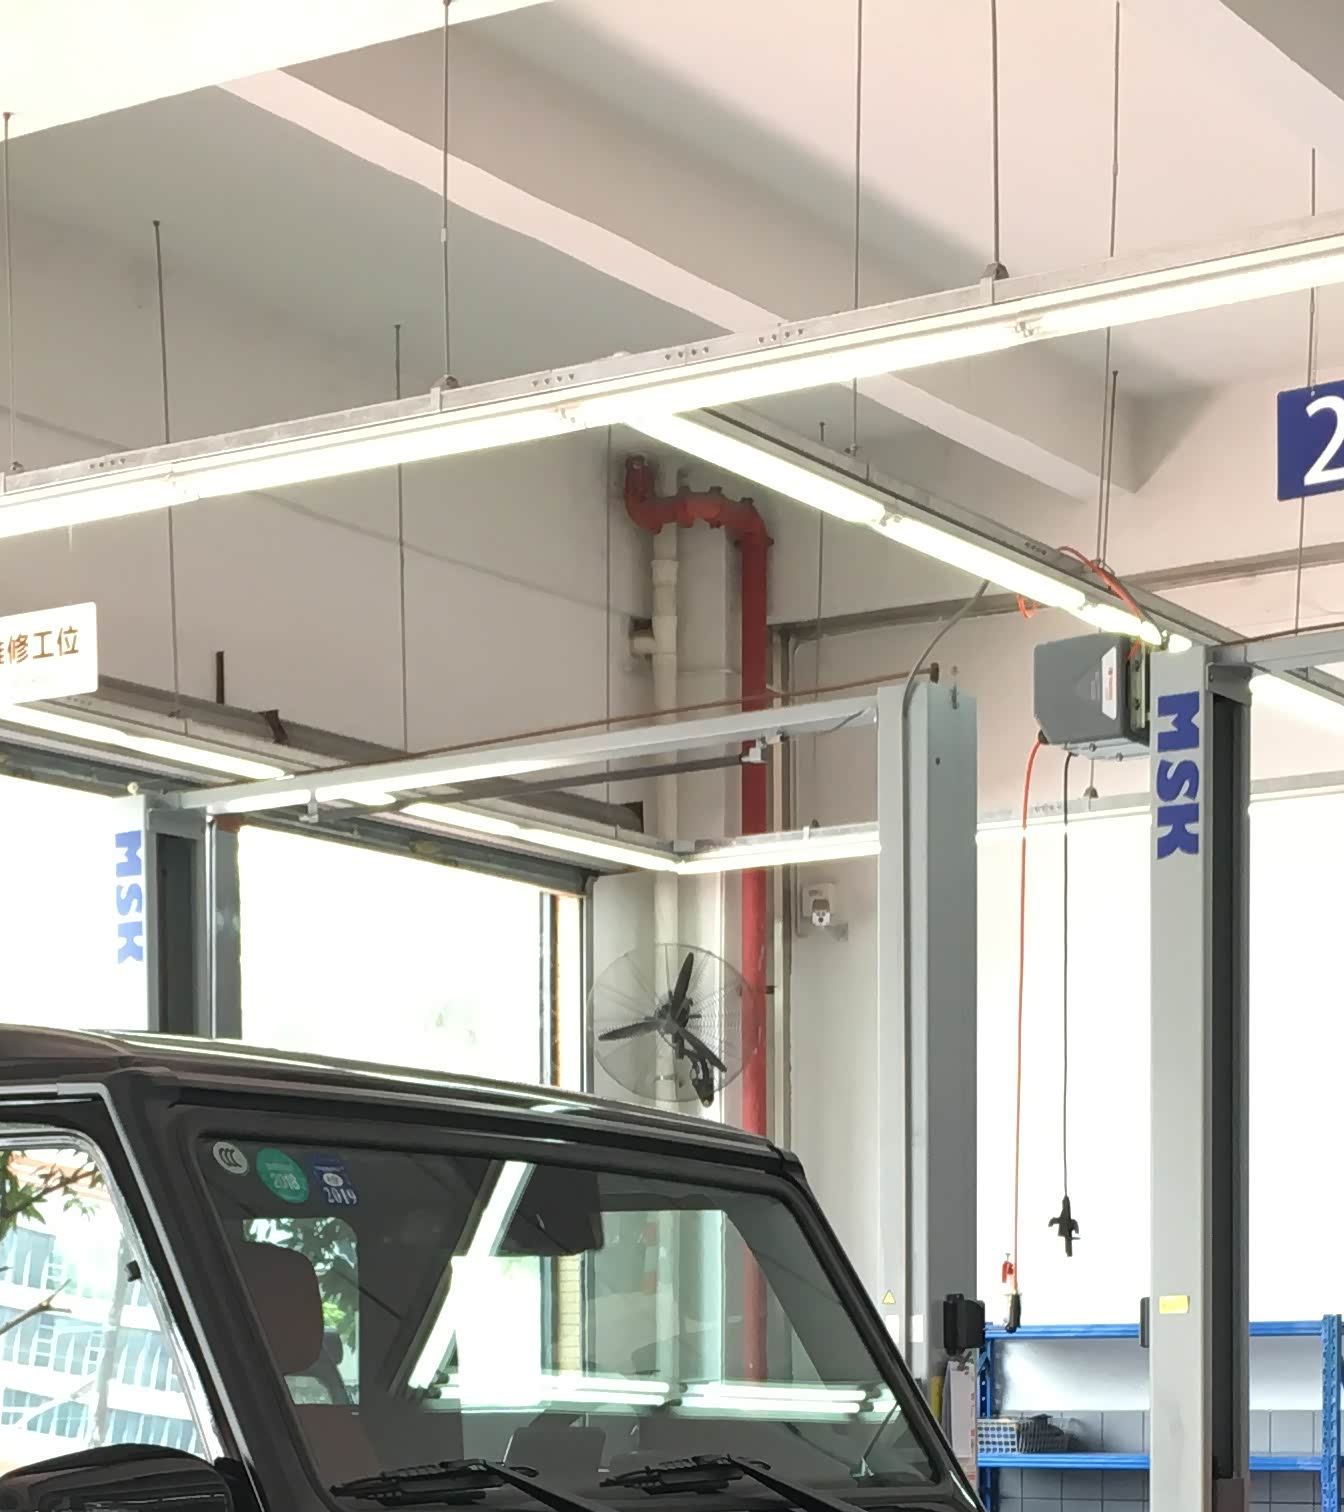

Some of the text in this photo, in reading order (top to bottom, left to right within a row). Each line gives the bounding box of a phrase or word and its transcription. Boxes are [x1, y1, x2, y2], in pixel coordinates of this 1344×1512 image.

[1157, 691, 1200, 860] MSK
[115, 829, 144, 964] MSK
[322, 1186, 358, 1205] 2019
